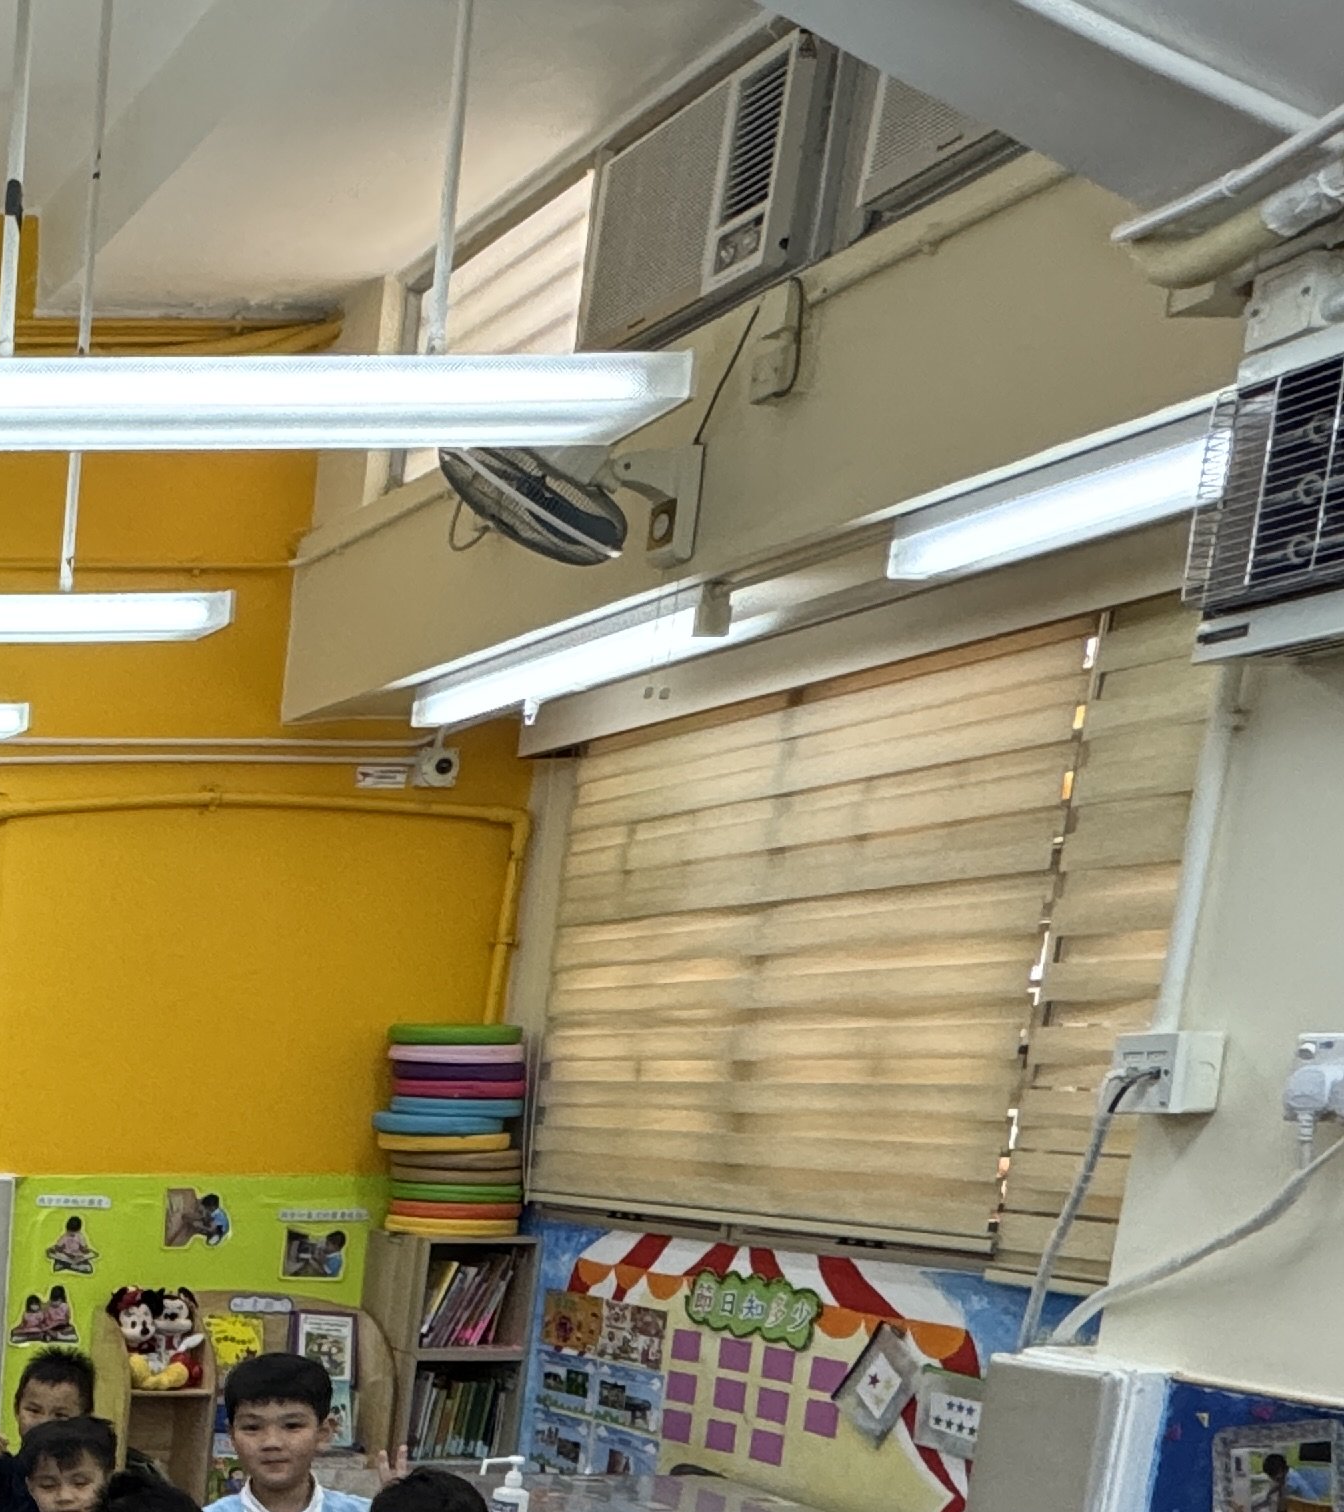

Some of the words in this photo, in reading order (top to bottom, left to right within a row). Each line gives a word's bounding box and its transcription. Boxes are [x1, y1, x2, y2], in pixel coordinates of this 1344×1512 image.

[693, 1282, 813, 1332] 節日知多少
